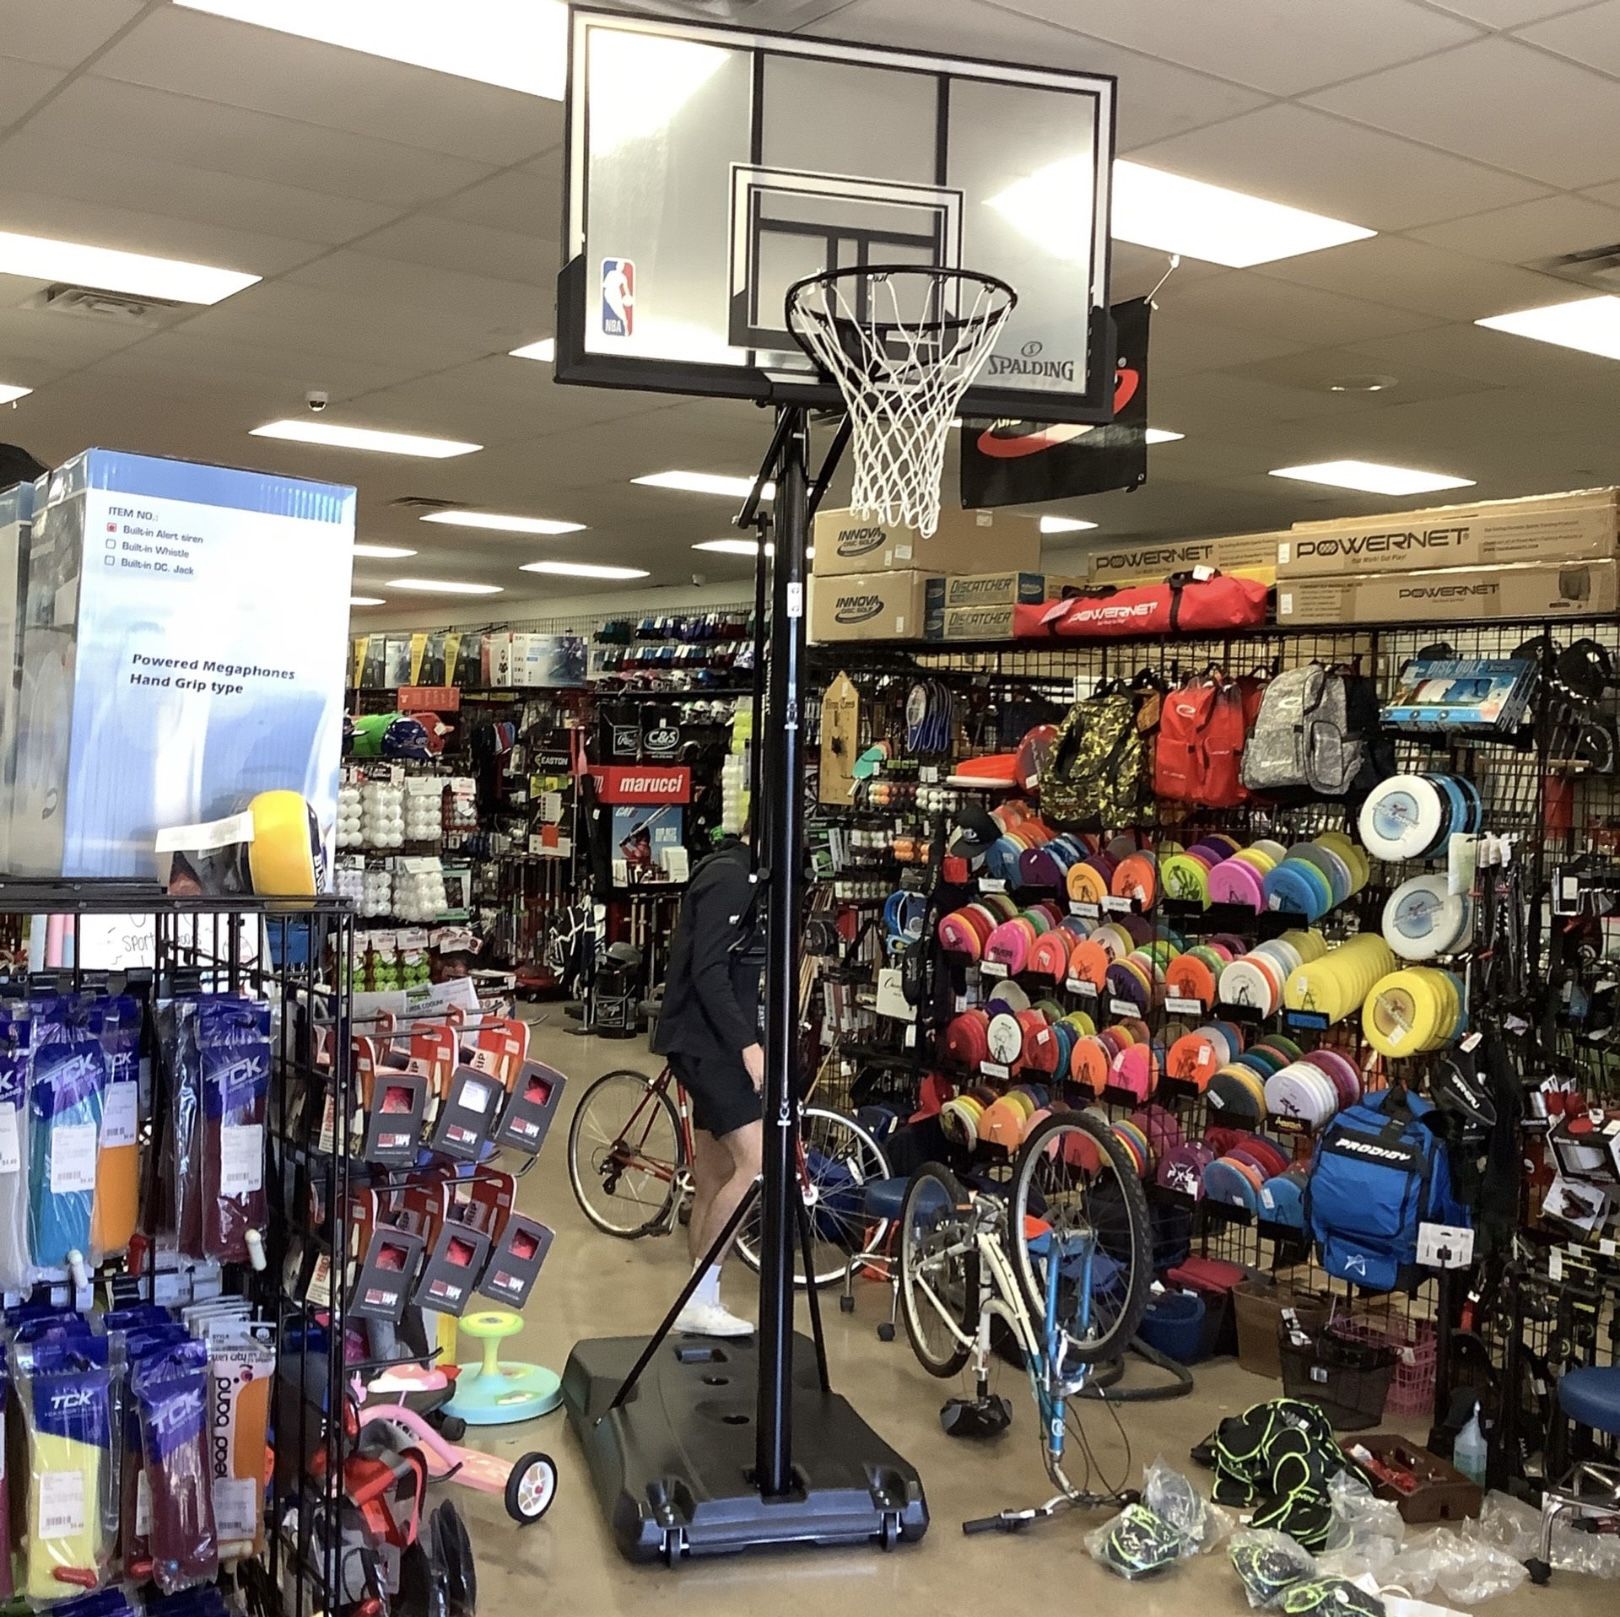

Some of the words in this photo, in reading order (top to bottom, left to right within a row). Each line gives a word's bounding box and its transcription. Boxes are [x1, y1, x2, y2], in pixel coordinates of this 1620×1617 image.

[605, 319, 622, 333] NBA
[988, 354, 1075, 382] SPALDING
[108, 506, 134, 518] ITEM
[123, 525, 154, 537] Built-in
[156, 529, 179, 541] Alert
[181, 534, 204, 544] siren
[837, 526, 881, 542] INNOVA
[1296, 527, 1470, 559] POWERNET
[121, 541, 153, 553] Built-in
[155, 545, 190, 559] Whistle
[1096, 545, 1214, 571] POWERNET
[121, 558, 152, 570] Built-in
[173, 565, 194, 575] Jack
[1399, 583, 1500, 600] POWERNET
[836, 595, 880, 608] INNOVA
[1068, 602, 1158, 624] POWERNET
[132, 653, 199, 670] Powered
[202, 660, 296, 680] Megaphones
[1427, 660, 1456, 674] DISC
[1455, 660, 1487, 673] GOLF
[129, 673, 171, 687] Hand
[175, 677, 207, 693] Grip
[210, 681, 244, 696] type
[648, 730, 677, 743] C&S
[541, 756, 569, 766] EASTON
[619, 774, 683, 793] marucci
[36, 1052, 97, 1092] TCK
[206, 1055, 263, 1096] TCK
[1335, 1137, 1412, 1161] PRODIGY
[51, 1391, 94, 1410] TCK
[215, 1377, 231, 1428] band
[150, 1388, 203, 1434] TCK
